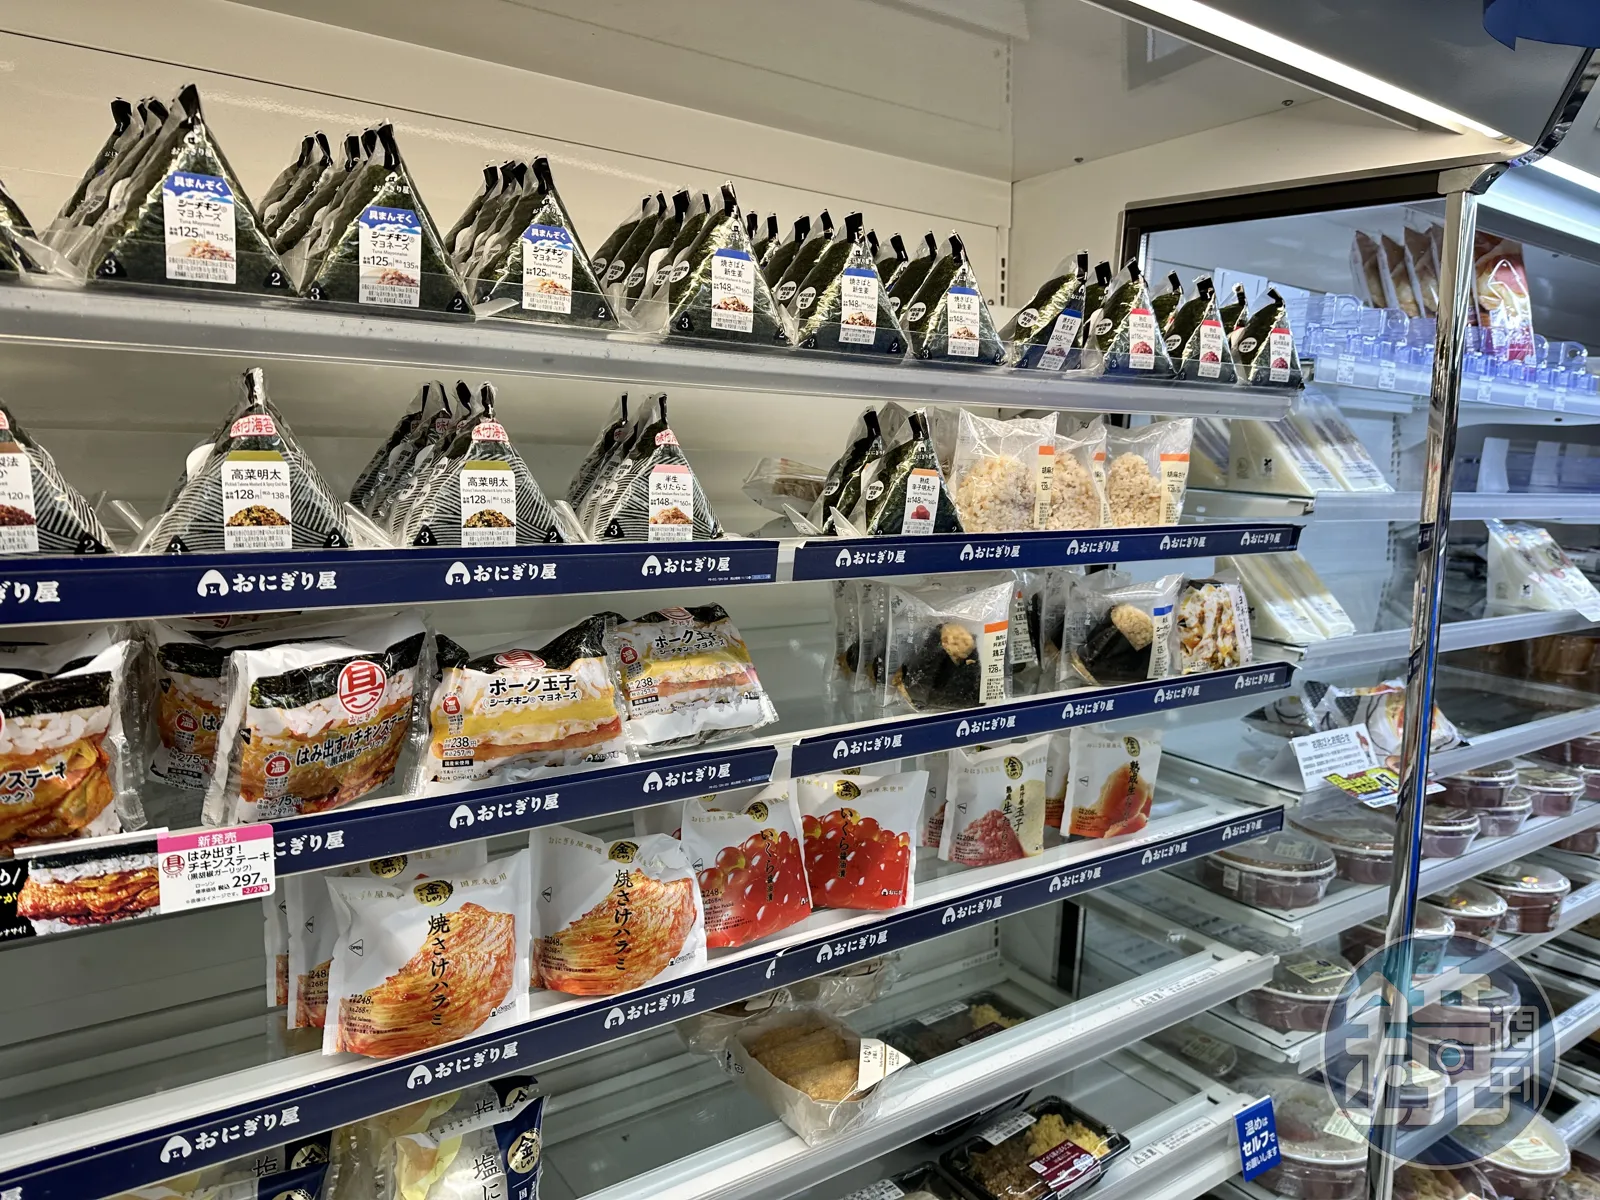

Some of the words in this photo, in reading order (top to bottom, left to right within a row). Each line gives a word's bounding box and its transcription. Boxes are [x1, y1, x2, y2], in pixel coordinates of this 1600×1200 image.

[173, 175, 223, 192] 具まんぞく
[176, 208, 222, 222] マヨネーズ
[368, 210, 412, 224] 具まんぞく
[531, 228, 566, 240] 具まんぞく
[370, 240, 410, 251] マヨネーズ
[532, 254, 564, 264] マヨネーズ
[720, 260, 746, 270] 焼さばと
[104, 259, 117, 275] 3
[271, 272, 281, 286] 2
[849, 277, 872, 286] 焼さばと
[310, 288, 320, 301] 3
[454, 298, 462, 310] 2
[598, 308, 606, 318] 2
[682, 318, 688, 328] 3
[808, 338, 815, 348] 3
[891, 342, 898, 352] 2
[924, 350, 929, 358] 3
[995, 354, 1000, 362] 2
[1112, 360, 1116, 368] 3
[231, 417, 275, 434] 味付海苔
[231, 468, 282, 480] 高菜明太
[468, 477, 508, 487] 高菜明太
[656, 483, 687, 491] 炙りたらこ
[421, 532, 430, 544] 3
[550, 532, 557, 542] 2
[610, 525, 618, 536] 3
[330, 534, 340, 547] 2
[1171, 536, 1206, 550] おにぎり屋
[1252, 532, 1282, 545] おにぎり屋
[84, 540, 96, 553] 2
[975, 544, 1020, 559] おにぎり屋
[1080, 540, 1119, 554] おにぎり屋
[852, 550, 906, 564] おにぎり屋
[474, 563, 557, 582] おにぎり屋
[664, 556, 730, 574] おにぎり屋
[232, 570, 338, 593] おにぎり屋
[654, 629, 718, 648] ポーク玉子
[623, 651, 634, 662] 温
[489, 674, 576, 696] ポーク玉子
[1244, 673, 1276, 688] おにぎり屋
[1164, 685, 1200, 702] おにぎり屋
[1074, 700, 1114, 716] おにぎり屋
[970, 716, 1016, 734] おにぎり屋
[849, 734, 903, 756] おにぎり屋
[664, 763, 732, 786] おにぎり屋
[476, 793, 560, 822] おにぎり屋
[1232, 819, 1262, 836] おにぎり屋
[198, 832, 237, 847] 新発売
[838, 806, 853, 878] いくら醤油漬
[188, 844, 242, 862] はみ出す!
[1153, 842, 1188, 860] おにぎり屋
[188, 852, 270, 872] チキンステーキ
[760, 829, 776, 902] いくら醤油漬
[232, 872, 268, 888] 297円
[1060, 866, 1102, 888] おにぎり屋
[956, 895, 1003, 918] おにぎり屋
[612, 870, 633, 970] 焼さけハラミ
[834, 931, 888, 958] おにぎり屋
[427, 913, 451, 1026] 焼さけハラミ
[628, 988, 696, 1022] おにぎり屋
[436, 1042, 519, 1078] おにぎり屋
[196, 1105, 300, 1150] おにぎり屋
[1244, 1116, 1268, 1136] 温めは
[516, 1136, 536, 1160] 金
[1242, 1130, 1276, 1157] セルフで
[520, 1156, 535, 1168] しゃり
[1246, 1146, 1278, 1171] お願いします
